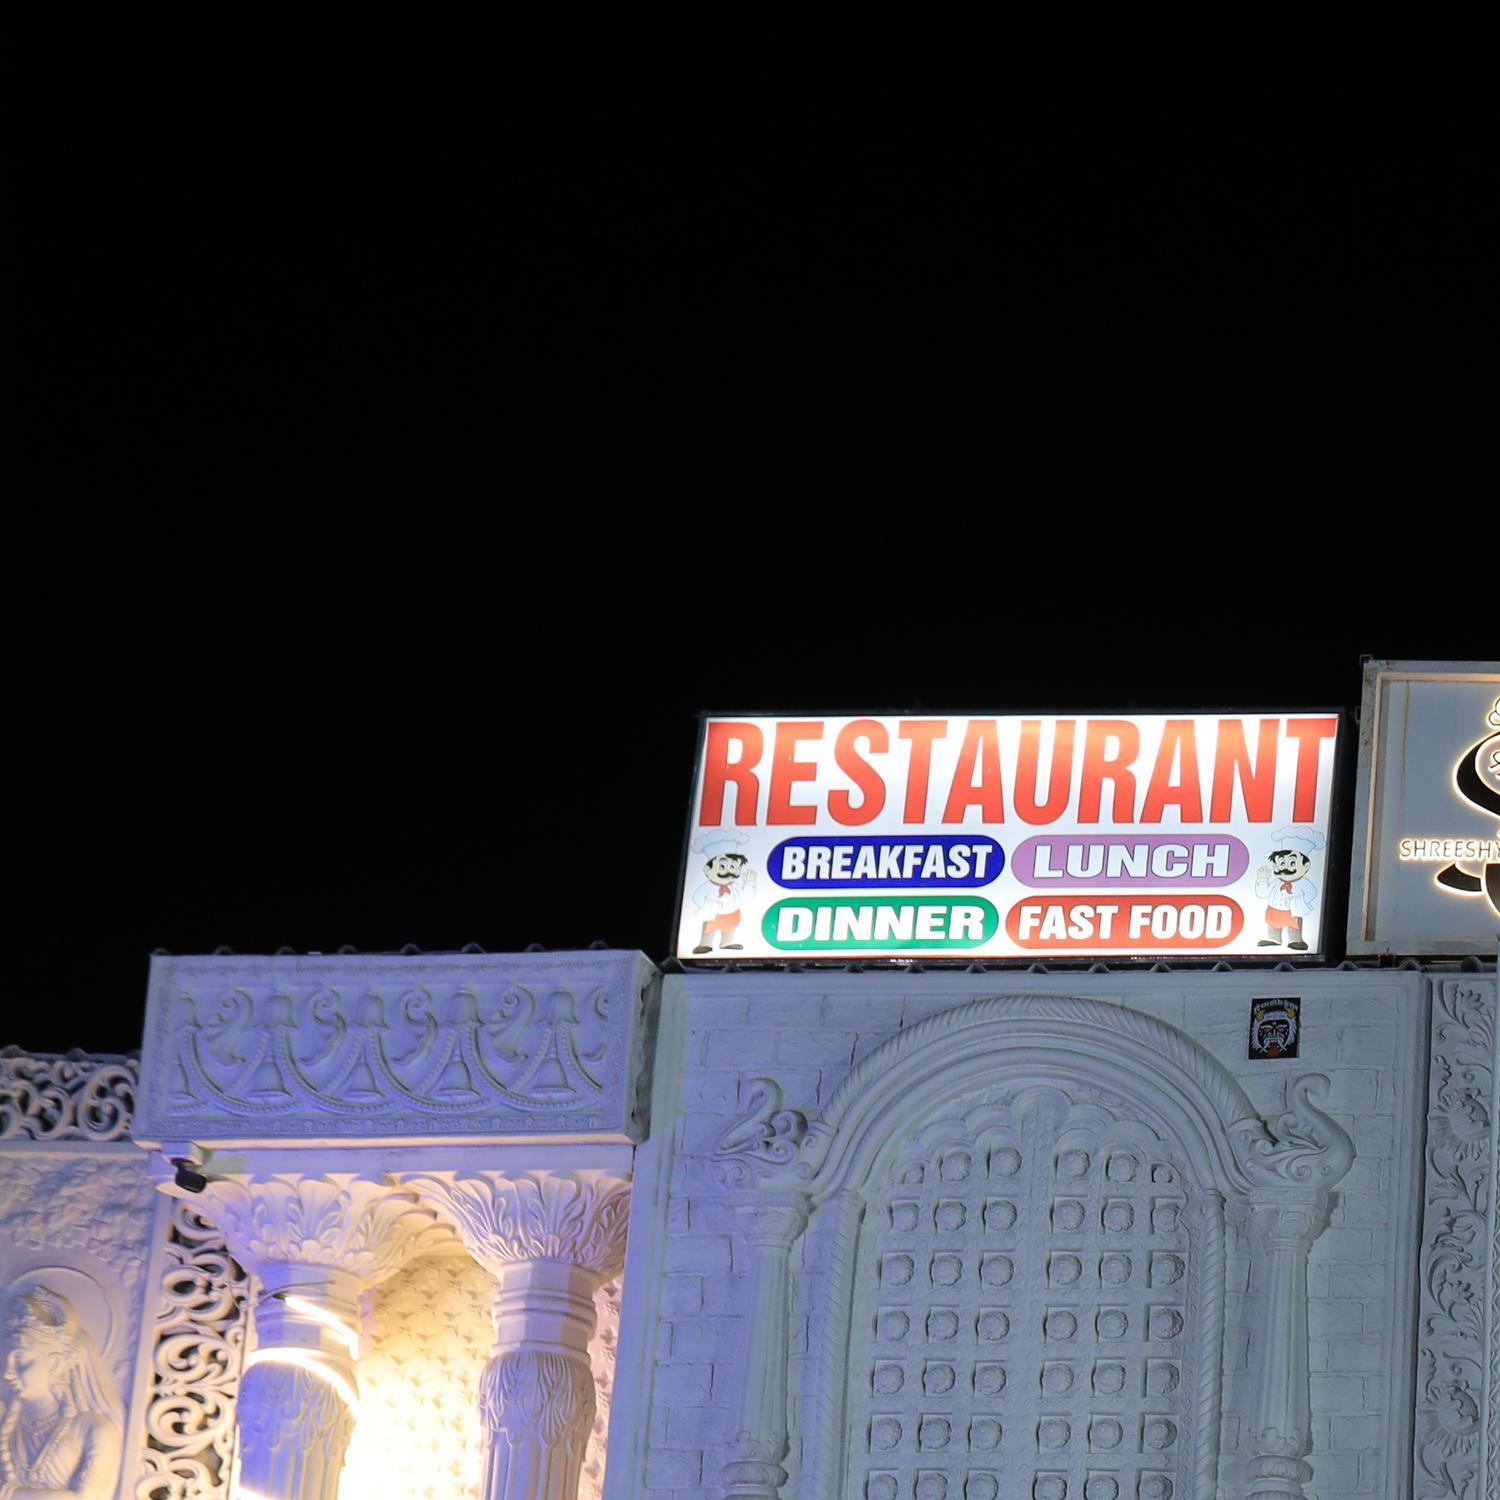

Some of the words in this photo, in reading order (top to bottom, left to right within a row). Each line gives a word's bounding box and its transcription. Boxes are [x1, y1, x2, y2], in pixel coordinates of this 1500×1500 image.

[699, 718, 1337, 827] RESTAURANT
[780, 843, 993, 882] BREAKFAST
[1032, 843, 1231, 879] LUNCH
[775, 903, 986, 943] DINNER
[1017, 904, 1119, 941] FAST
[1127, 903, 1233, 941] FOOD
